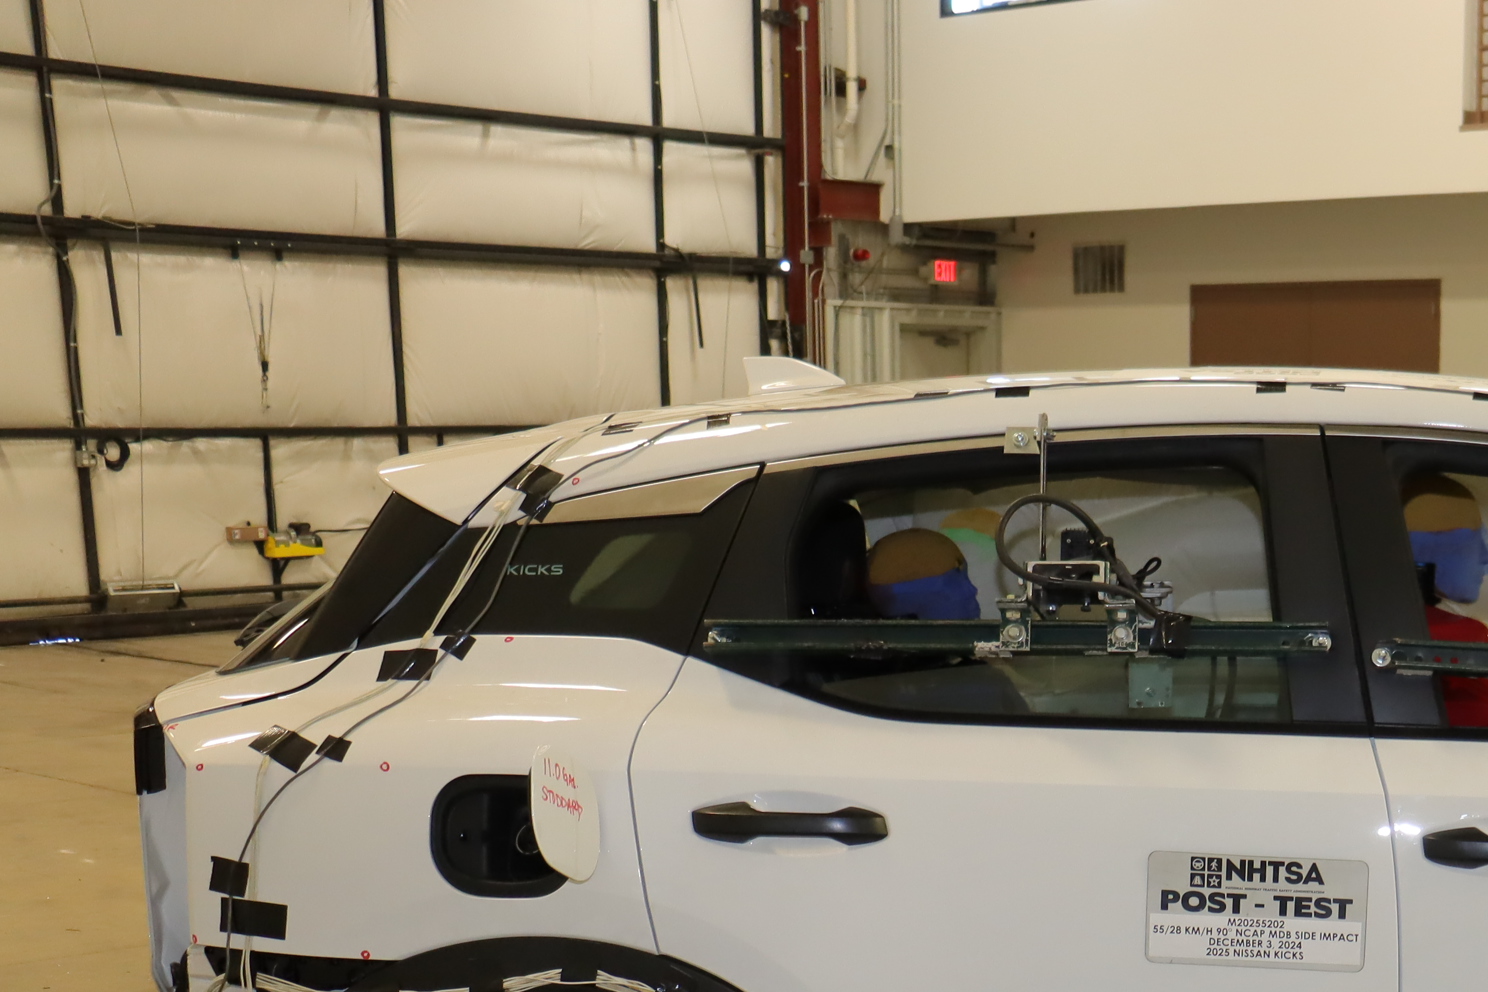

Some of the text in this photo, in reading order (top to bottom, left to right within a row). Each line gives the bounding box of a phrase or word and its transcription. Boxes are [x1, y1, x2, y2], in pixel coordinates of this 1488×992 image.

[934, 260, 957, 282] EXIT
[506, 564, 564, 576] KICKS
[543, 757, 561, 781] 11.0
[1225, 858, 1325, 885] NHTSA
[1160, 889, 1247, 914] POST
[1273, 895, 1354, 920] TEST
[1227, 918, 1285, 929] M20255202
[1153, 925, 1359, 942] 55/28 KM/H 90° NCAP MDB SIDE IMPACT
[1208, 937, 1303, 950] DECEMBER 3, 2024
[1205, 947, 1304, 960] 2025 NISSAN KICKS
